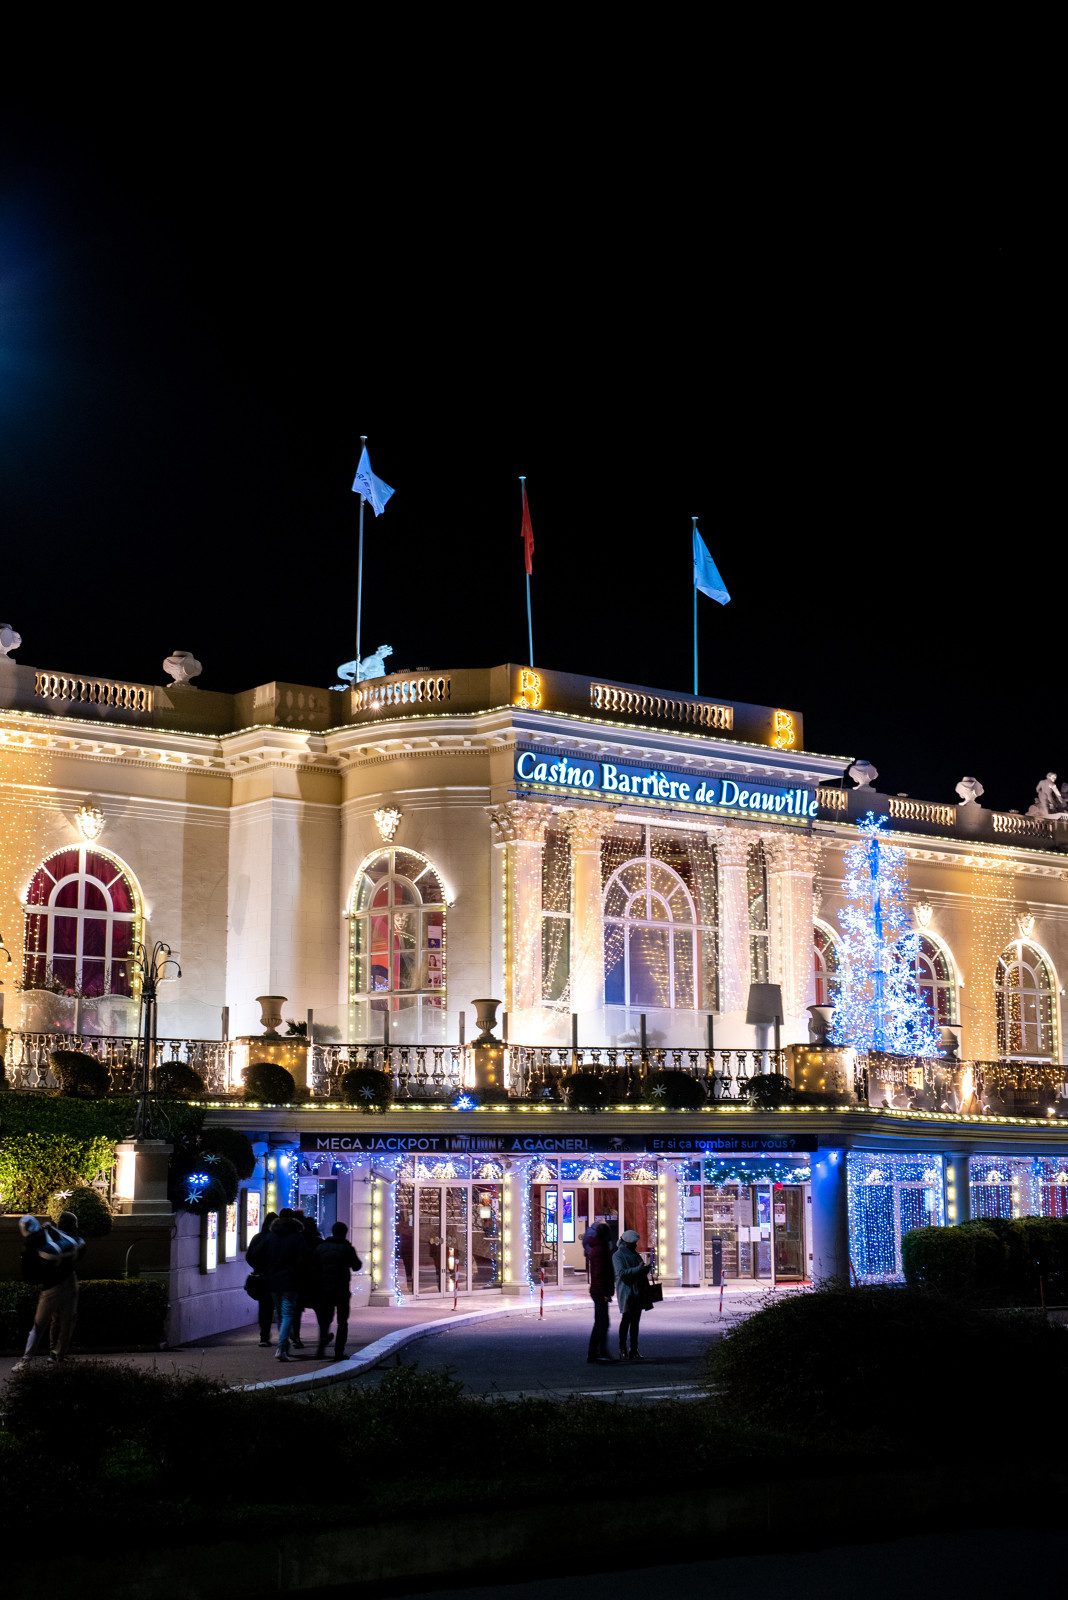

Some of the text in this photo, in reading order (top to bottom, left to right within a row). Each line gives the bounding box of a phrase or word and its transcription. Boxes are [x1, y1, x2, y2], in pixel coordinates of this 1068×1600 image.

[518, 669, 542, 707] B
[774, 710, 796, 748] B
[517, 752, 819, 817] Casino Barrière de Deauville
[316, 1138, 363, 1150] MEGA
[366, 1138, 439, 1150] JACKPOT
[667, 1138, 676, 1149] si
[679, 1139, 693, 1151] ça
[695, 1138, 739, 1149] tombait
[741, 1140, 758, 1149] sur
[760, 1140, 788, 1149] vous
